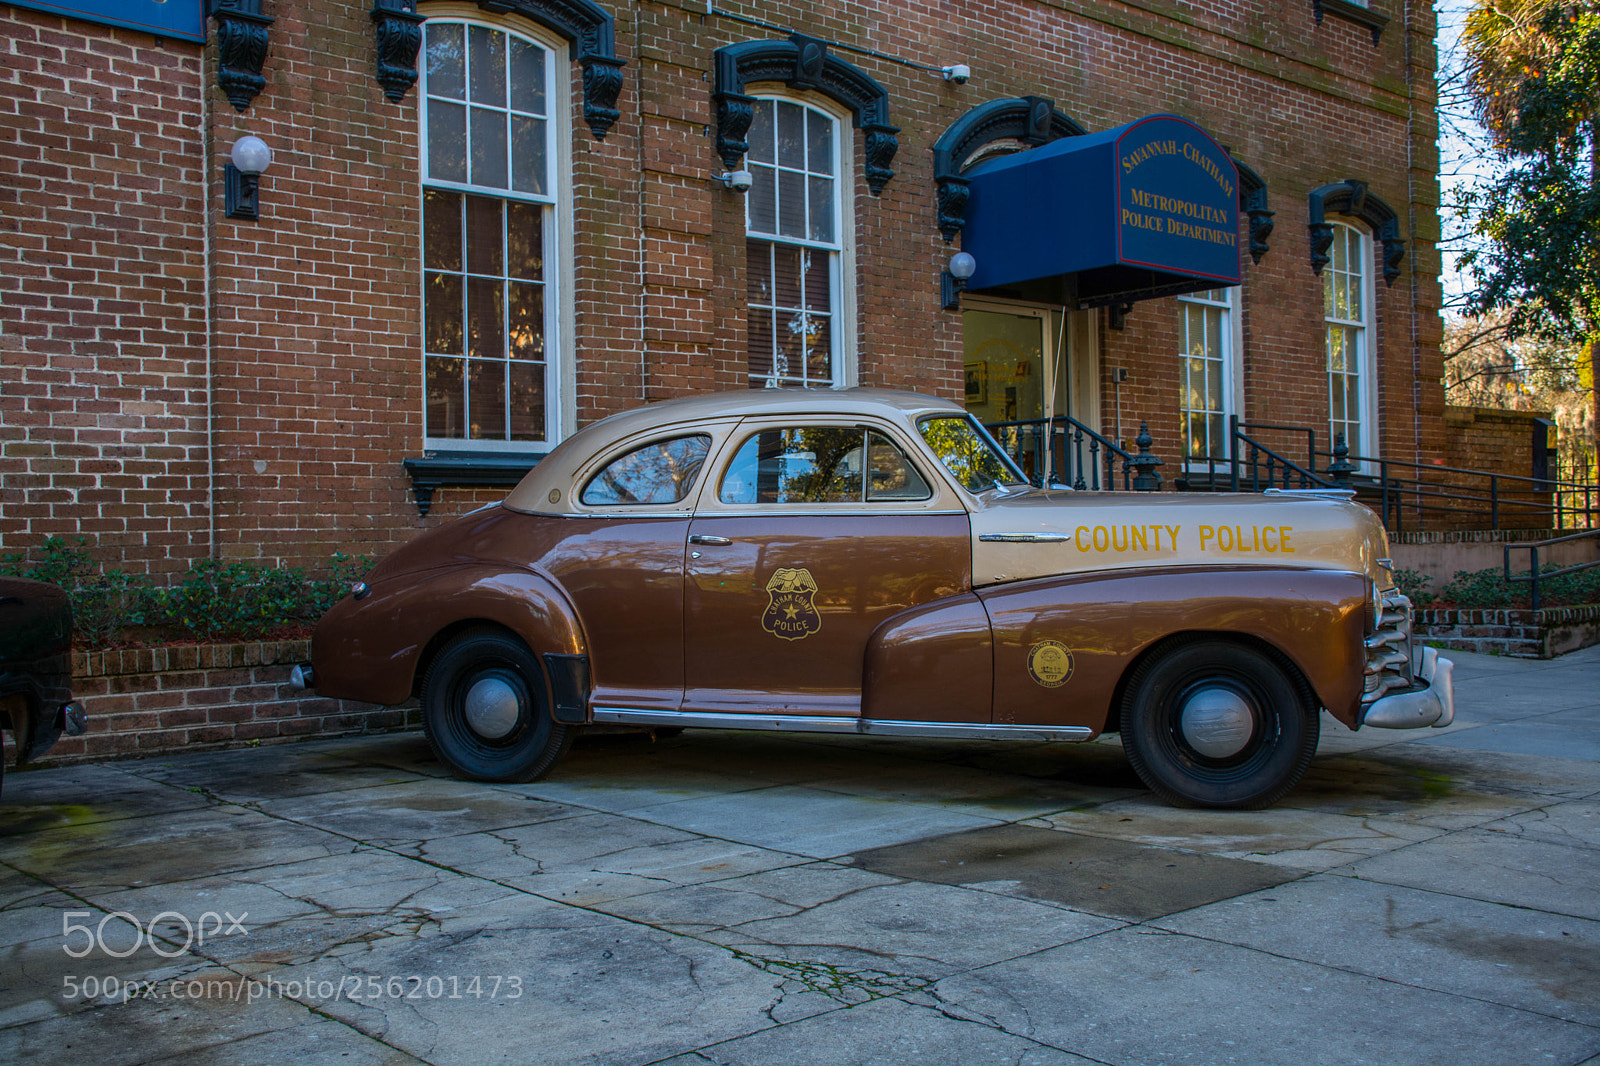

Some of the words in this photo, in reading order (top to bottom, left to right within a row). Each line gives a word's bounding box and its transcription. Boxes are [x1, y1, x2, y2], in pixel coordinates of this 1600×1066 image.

[1131, 188, 1228, 224] METROPOLITAN
[1122, 208, 1164, 232] POLICE
[1167, 217, 1237, 247] DEPARTMENT
[1075, 524, 1181, 552] COUNTY
[1198, 525, 1296, 553] POLICE
[769, 593, 793, 615] CHATHAM
[794, 594, 814, 615] COUNTY
[773, 620, 809, 631] POLICE
